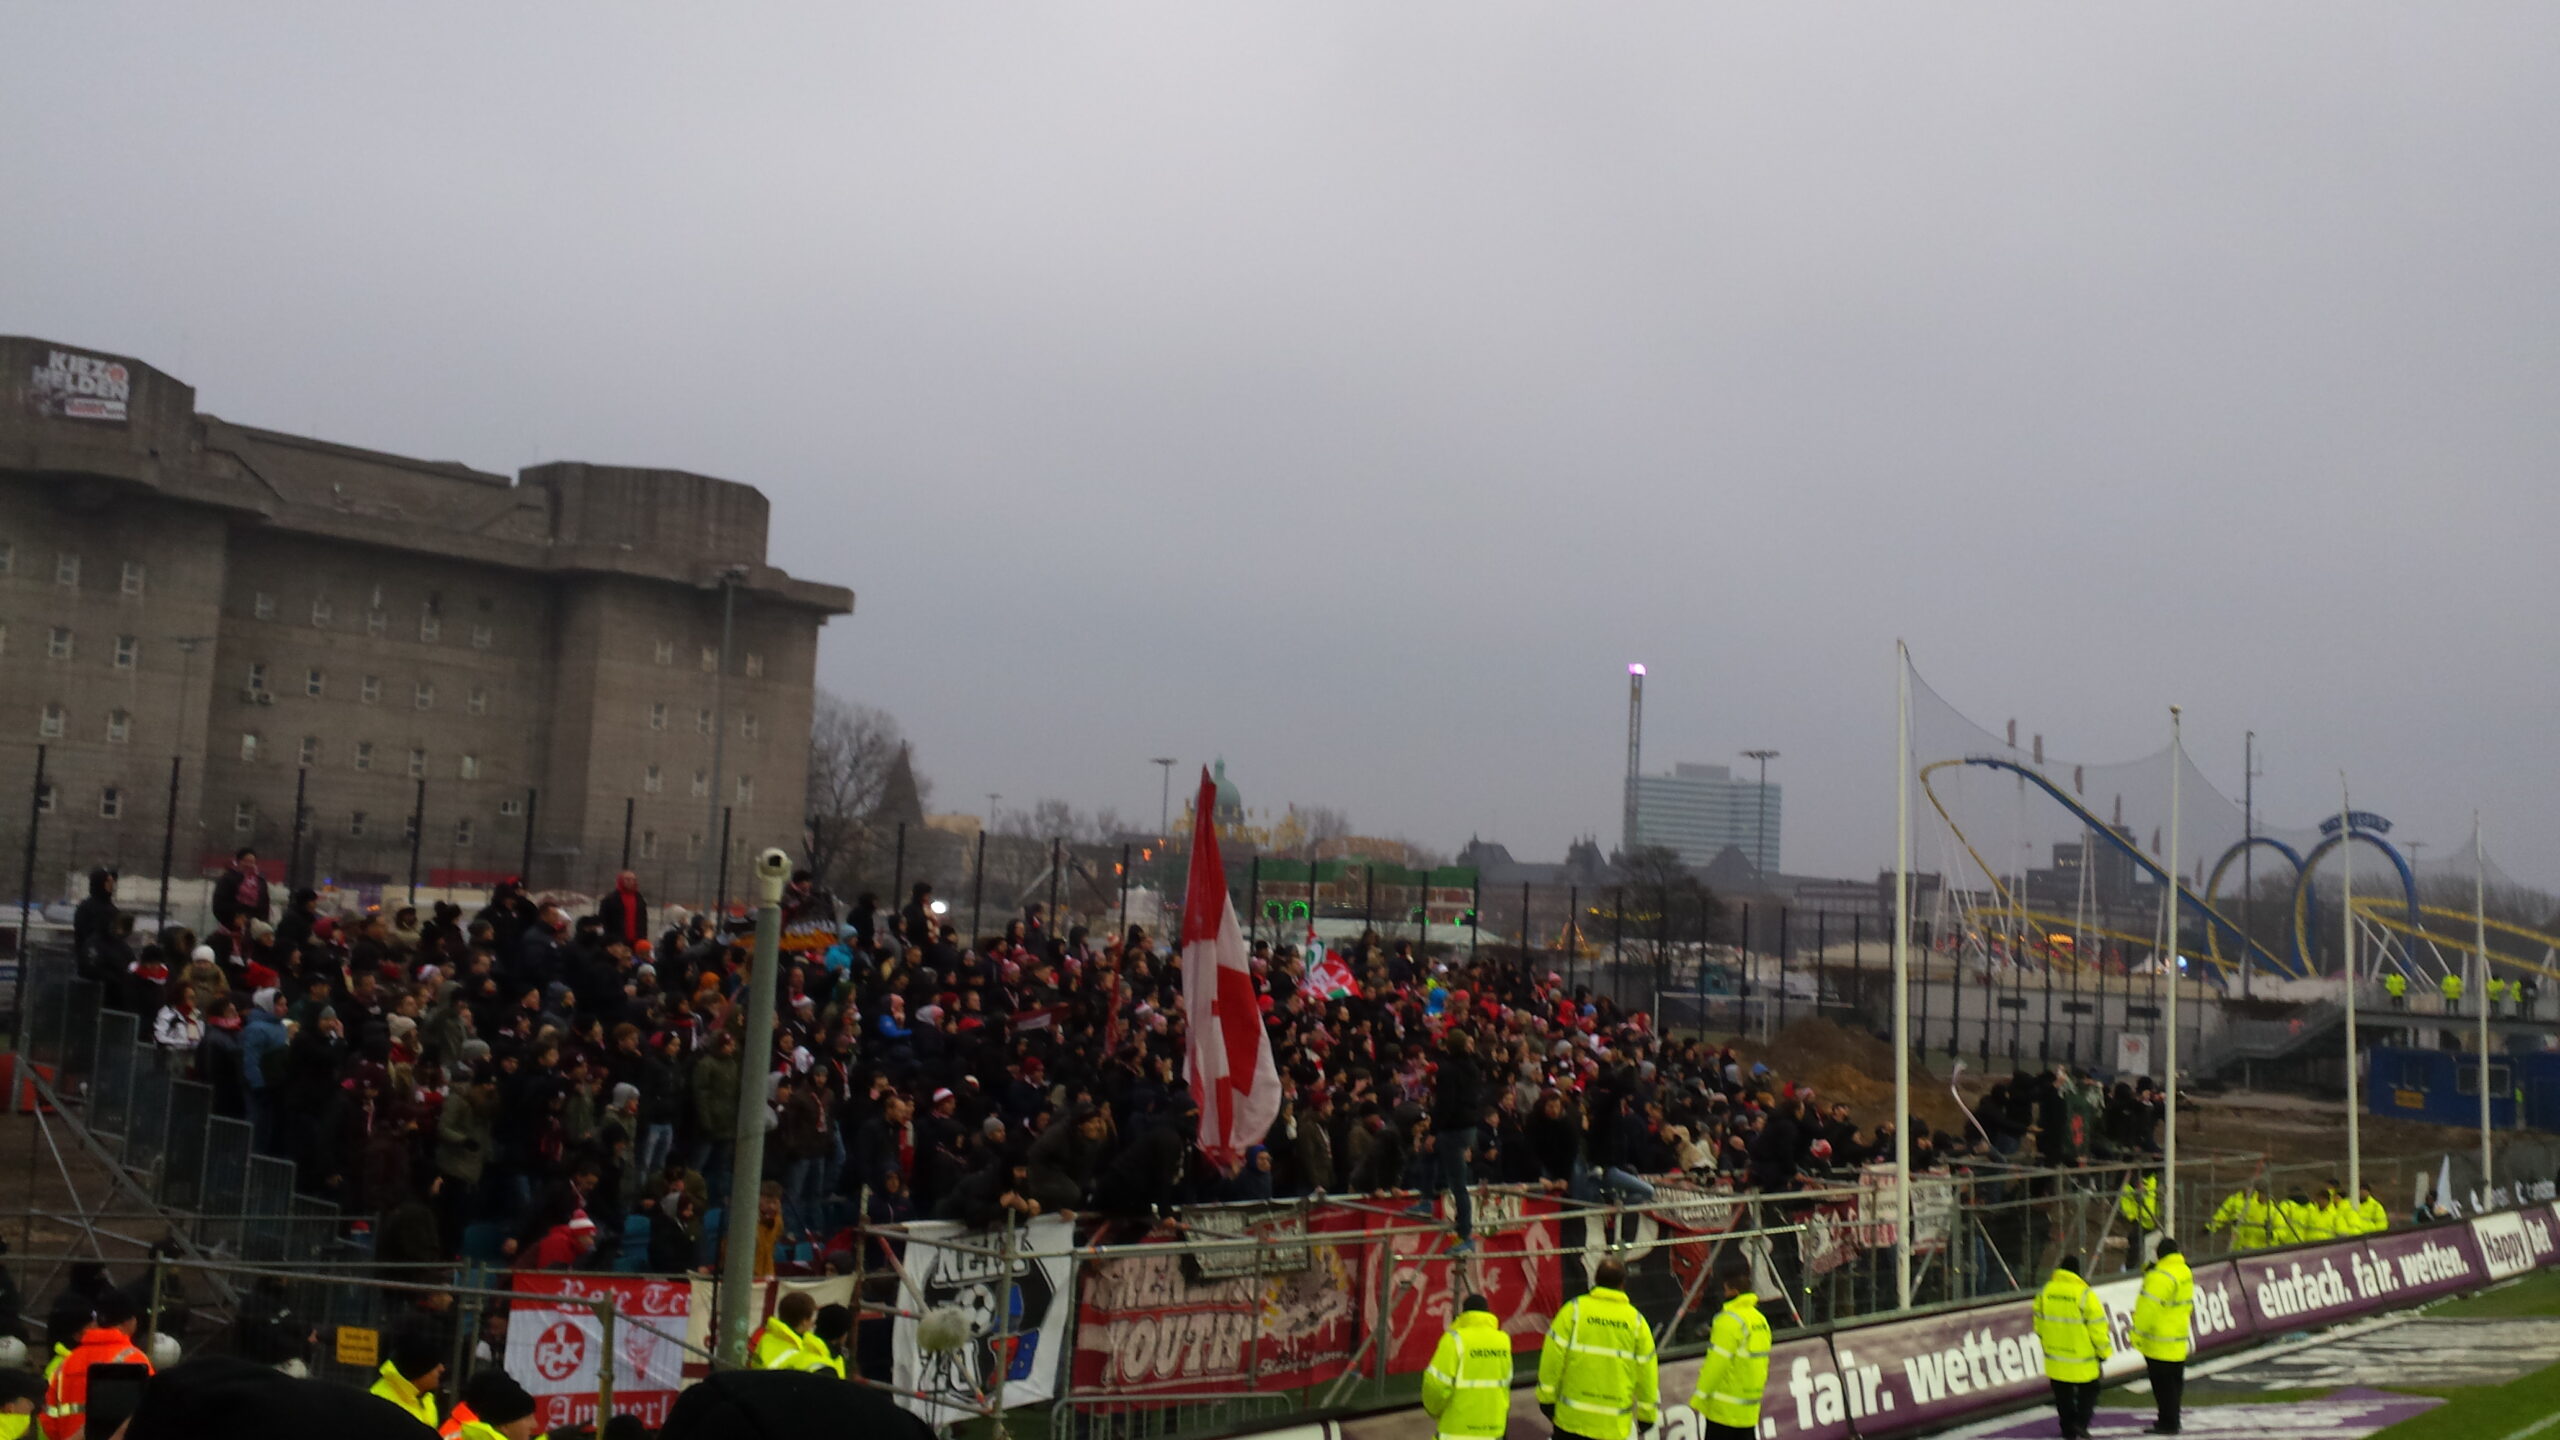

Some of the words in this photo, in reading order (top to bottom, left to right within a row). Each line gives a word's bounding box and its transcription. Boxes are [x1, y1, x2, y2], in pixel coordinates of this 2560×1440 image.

[2481, 1230, 2528, 1269] Happy
[2257, 1257, 2352, 1320] einfach.
[2351, 1248, 2399, 1299] fair.
[2397, 1239, 2469, 1288] wetten.
[1586, 1316, 1629, 1330] ORDNER
[2193, 1281, 2236, 1336] Bet
[1104, 1313, 1248, 1383] YOUTH
[1469, 1348, 1508, 1359] ORDNER
[1790, 1350, 1894, 1431] fair.
